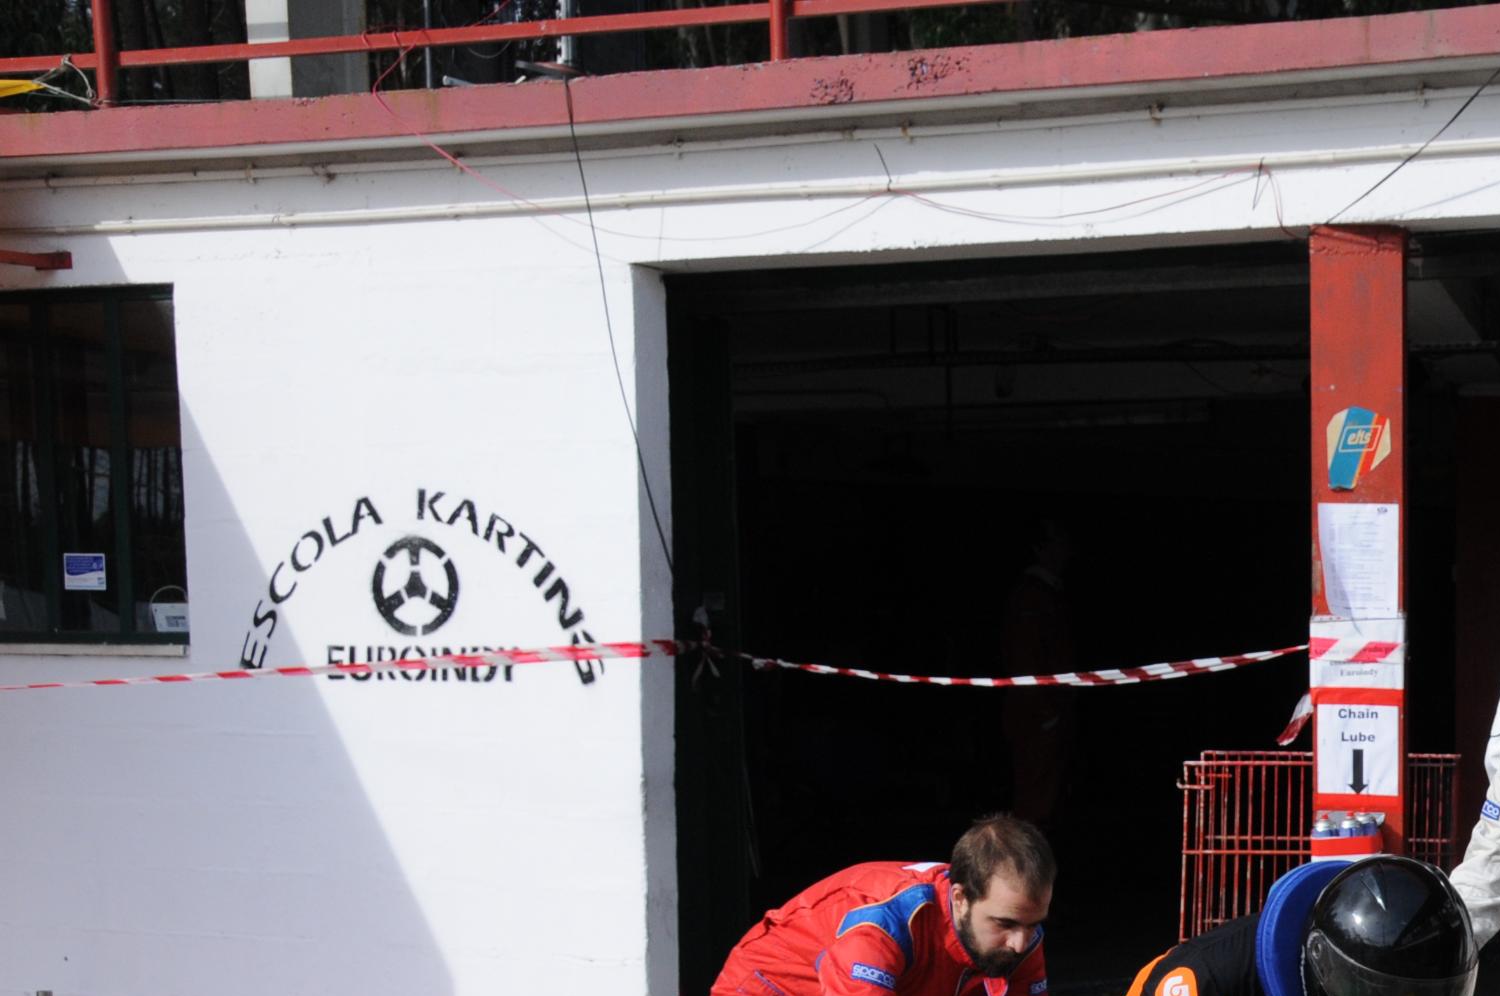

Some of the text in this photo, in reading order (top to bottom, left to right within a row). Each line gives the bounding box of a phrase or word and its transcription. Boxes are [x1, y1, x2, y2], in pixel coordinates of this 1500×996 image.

[239, 488, 605, 686] ESCOLA KARTING
[1338, 708, 1379, 720] Chain
[1340, 731, 1376, 742] Lube
[852, 963, 897, 987] sparco
